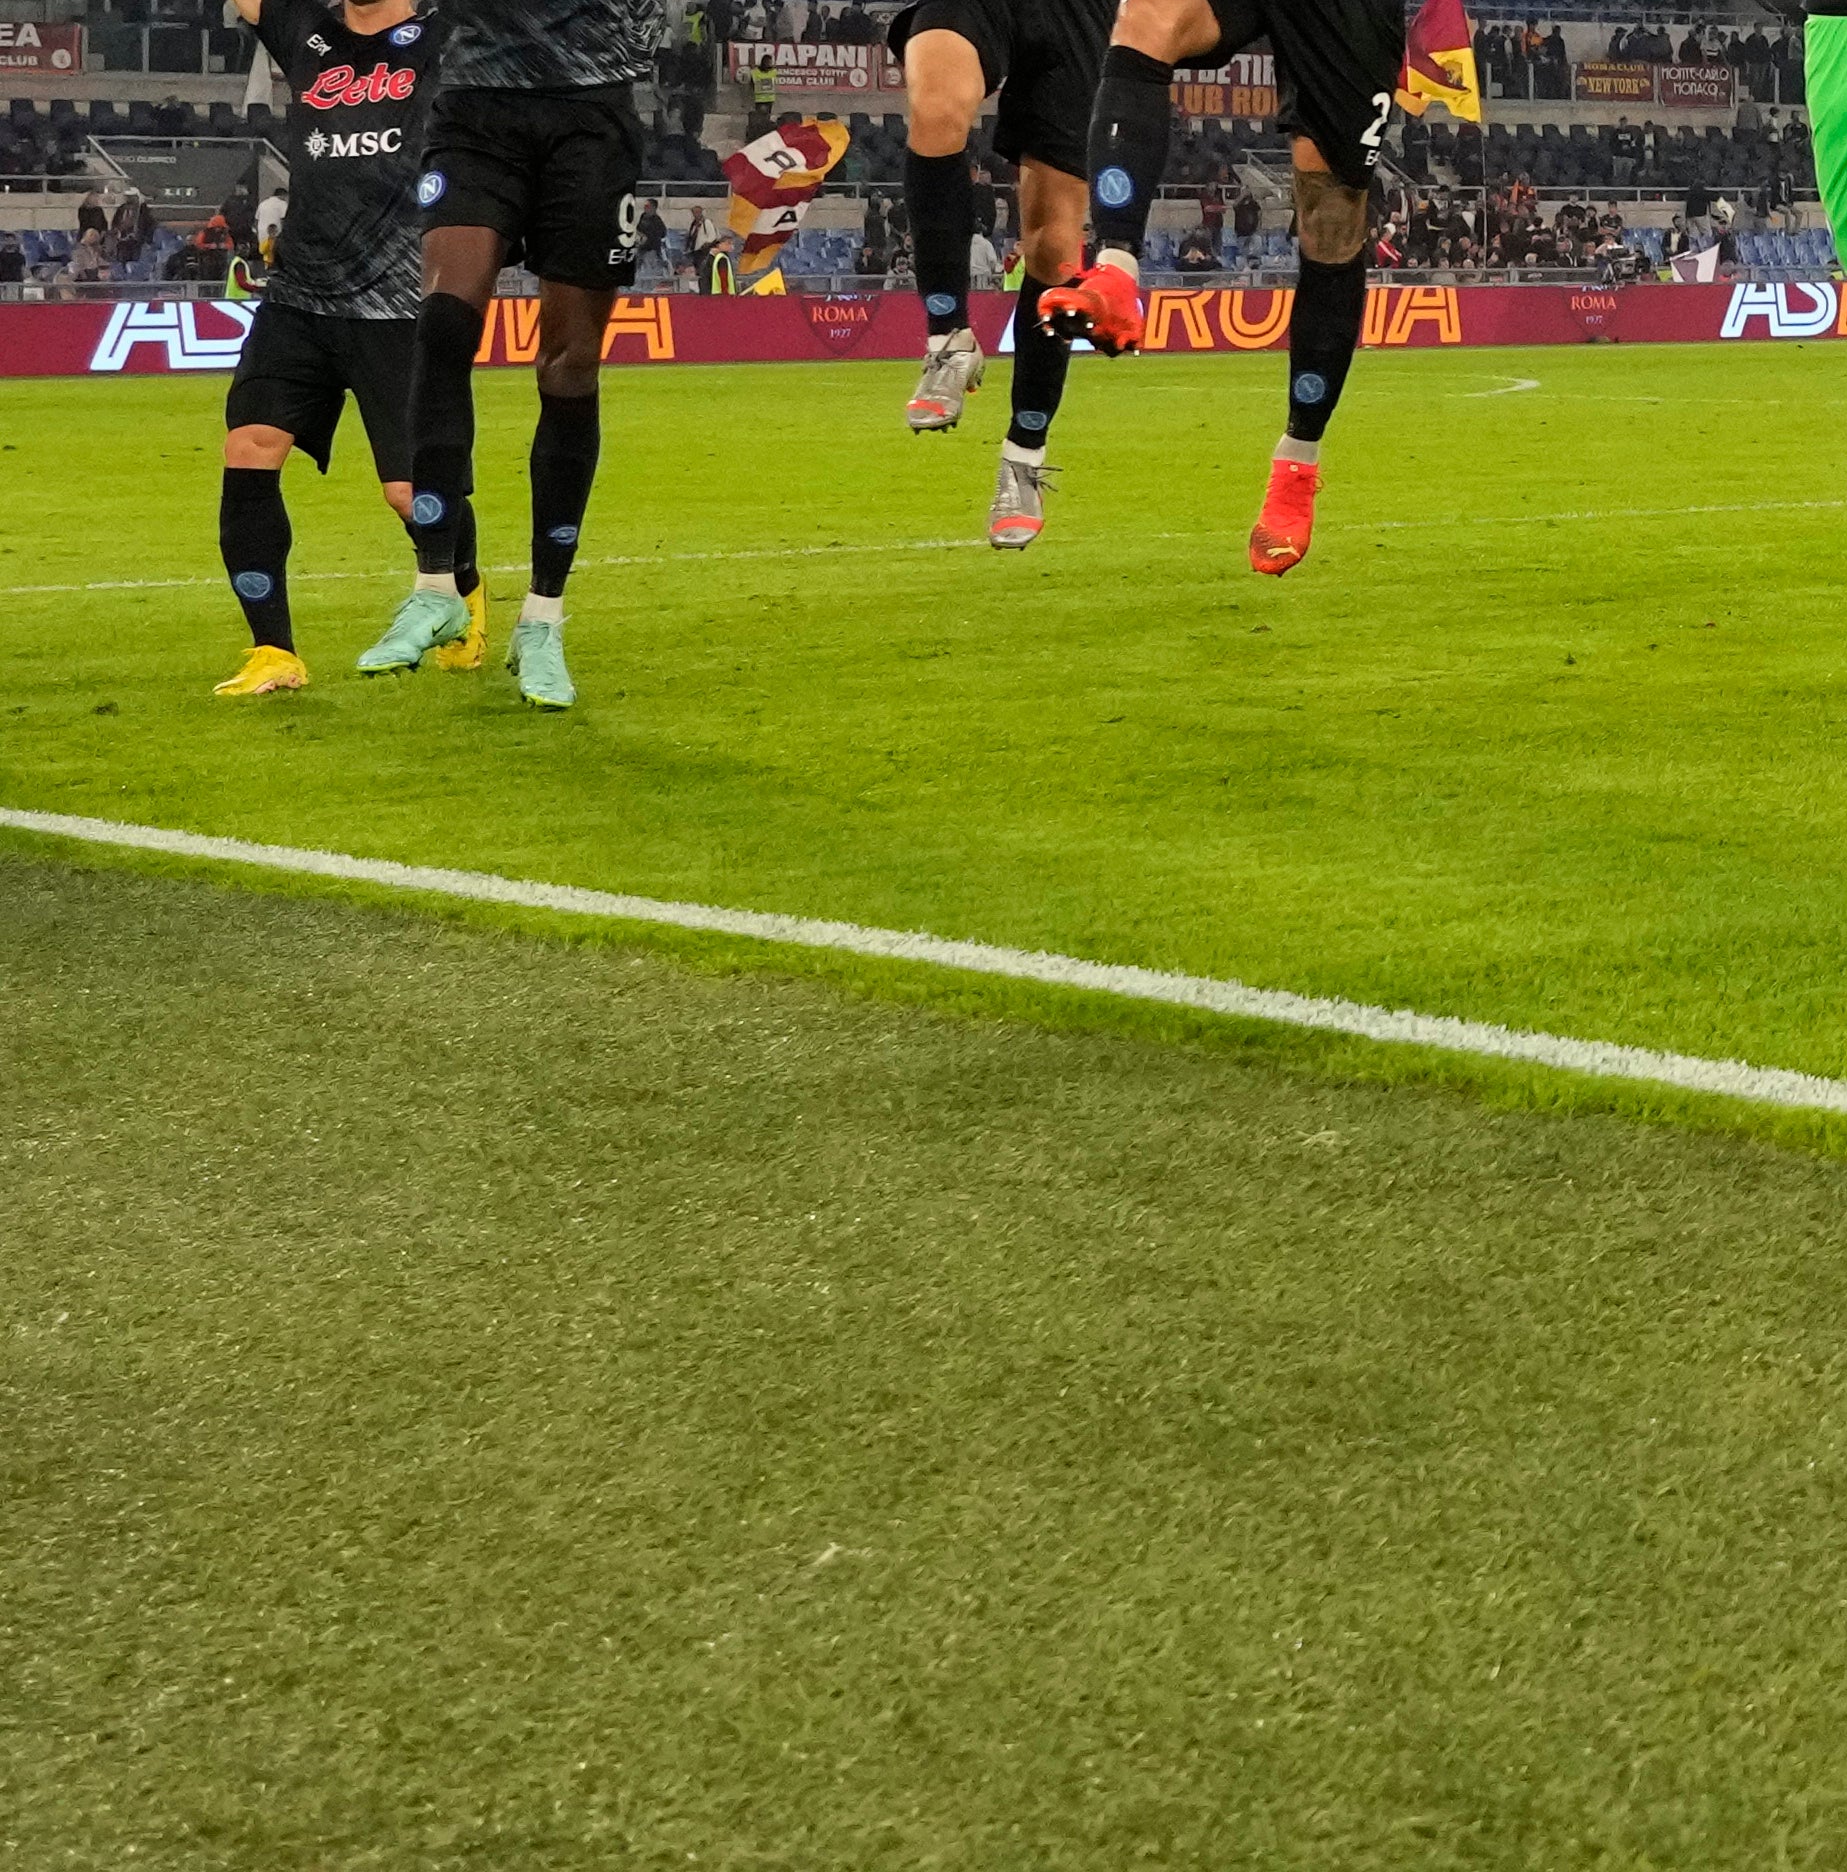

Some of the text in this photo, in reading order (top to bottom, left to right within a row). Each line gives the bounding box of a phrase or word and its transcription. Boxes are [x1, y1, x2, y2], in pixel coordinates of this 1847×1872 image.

[734, 43, 868, 67] TRAPANI
[301, 62, 416, 110] Lete
[1587, 76, 1640, 95] NEW YORK
[1169, 84, 1224, 115] LUB
[330, 128, 402, 158] MSC
[618, 193, 637, 248] 9
[812, 306, 870, 323] ROMA
[1571, 295, 1617, 310] ROMA
